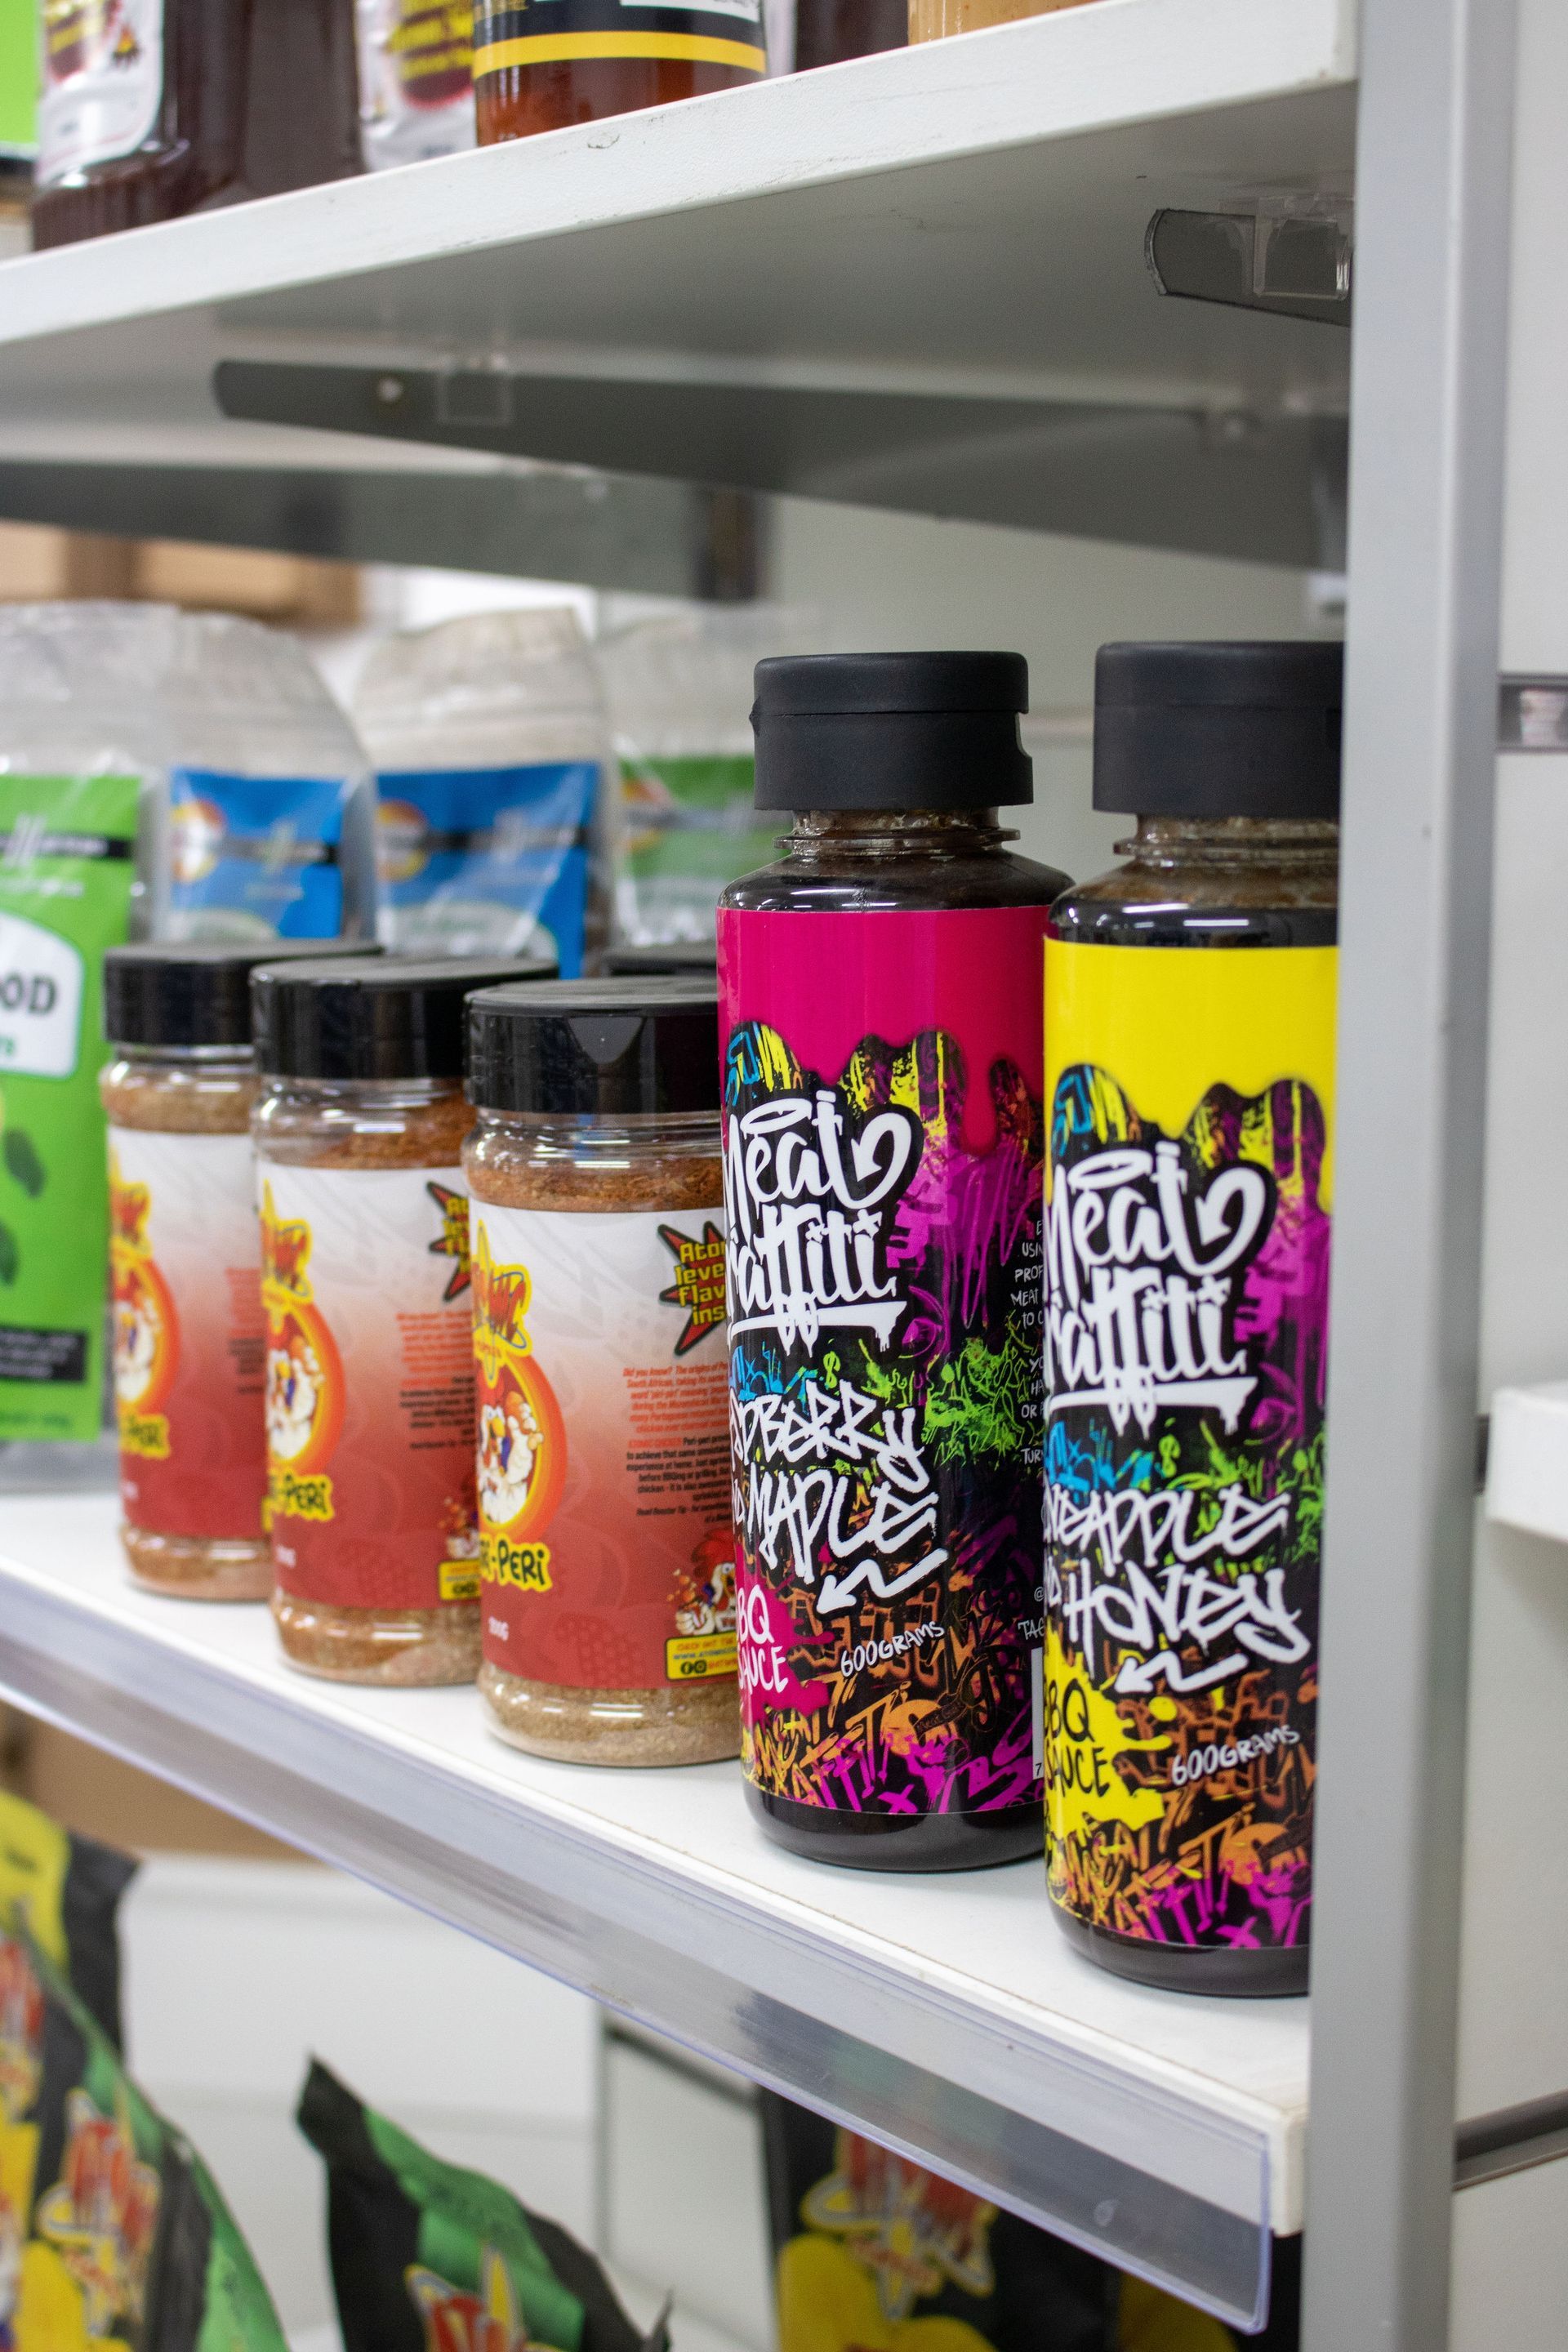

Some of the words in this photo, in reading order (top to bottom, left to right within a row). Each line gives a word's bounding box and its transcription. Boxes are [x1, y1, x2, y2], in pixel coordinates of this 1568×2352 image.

[0, 973, 57, 1014] OD
[674, 1263, 725, 1286] leve
[678, 1283, 725, 1307] flav
[1010, 1287, 1039, 1307] MEAT
[693, 1303, 725, 1325] ins
[1021, 1403, 1037, 1419] OR
[746, 1461, 940, 1585] MAPLE
[1063, 1557, 1312, 1681] HONEY
[840, 1620, 946, 1677] 600GRAMS
[1171, 1723, 1301, 1786] 600GRAMS
